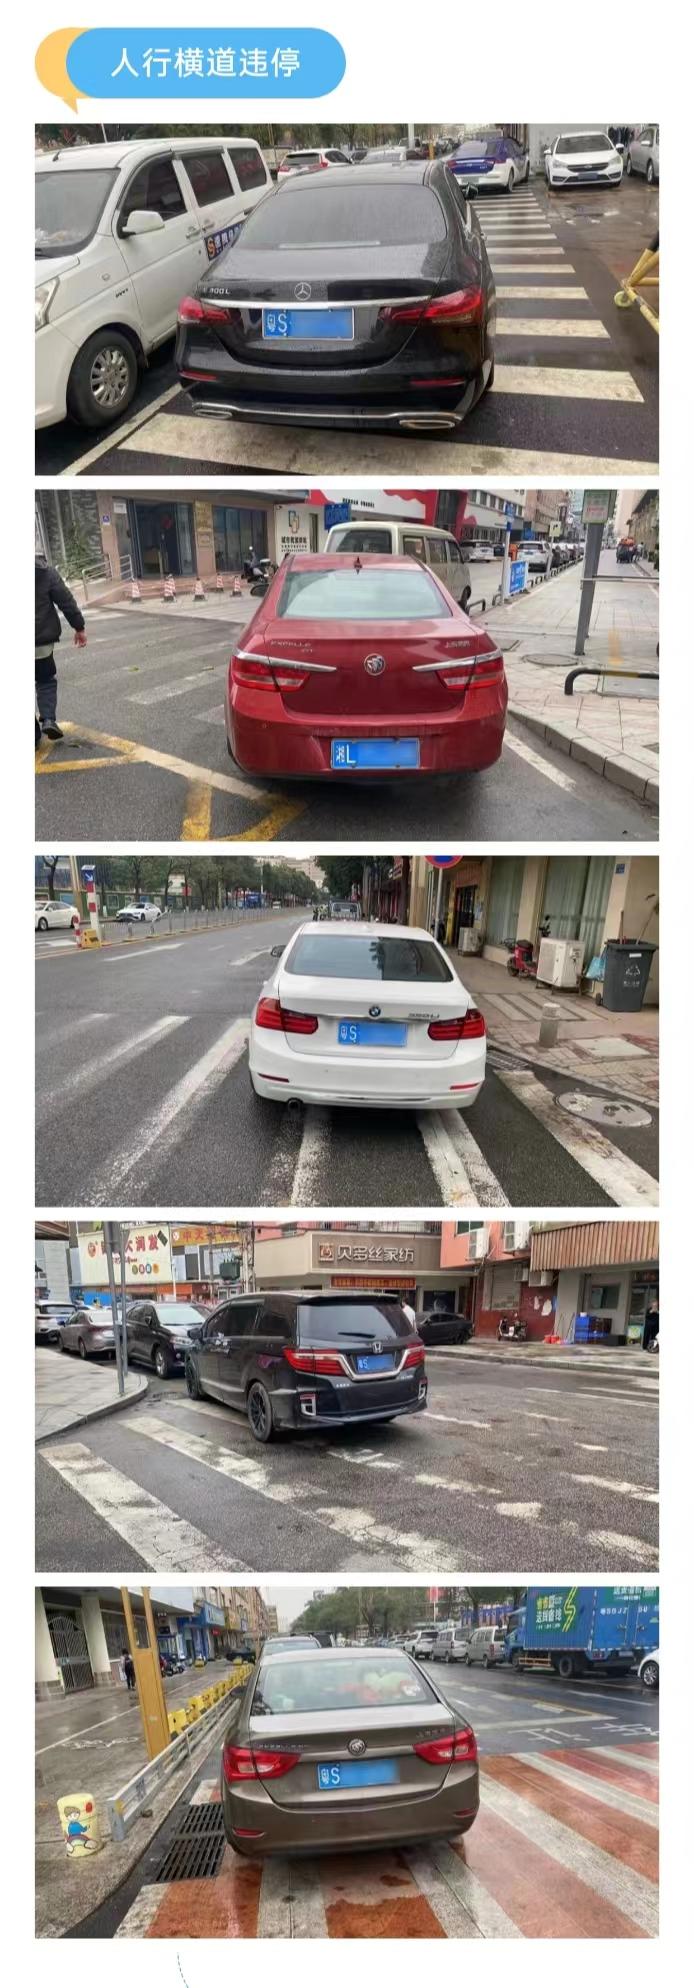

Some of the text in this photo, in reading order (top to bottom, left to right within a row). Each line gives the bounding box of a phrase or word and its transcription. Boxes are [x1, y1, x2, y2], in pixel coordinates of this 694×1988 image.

[338, 1244, 415, 1263] 贝多丝家纺
